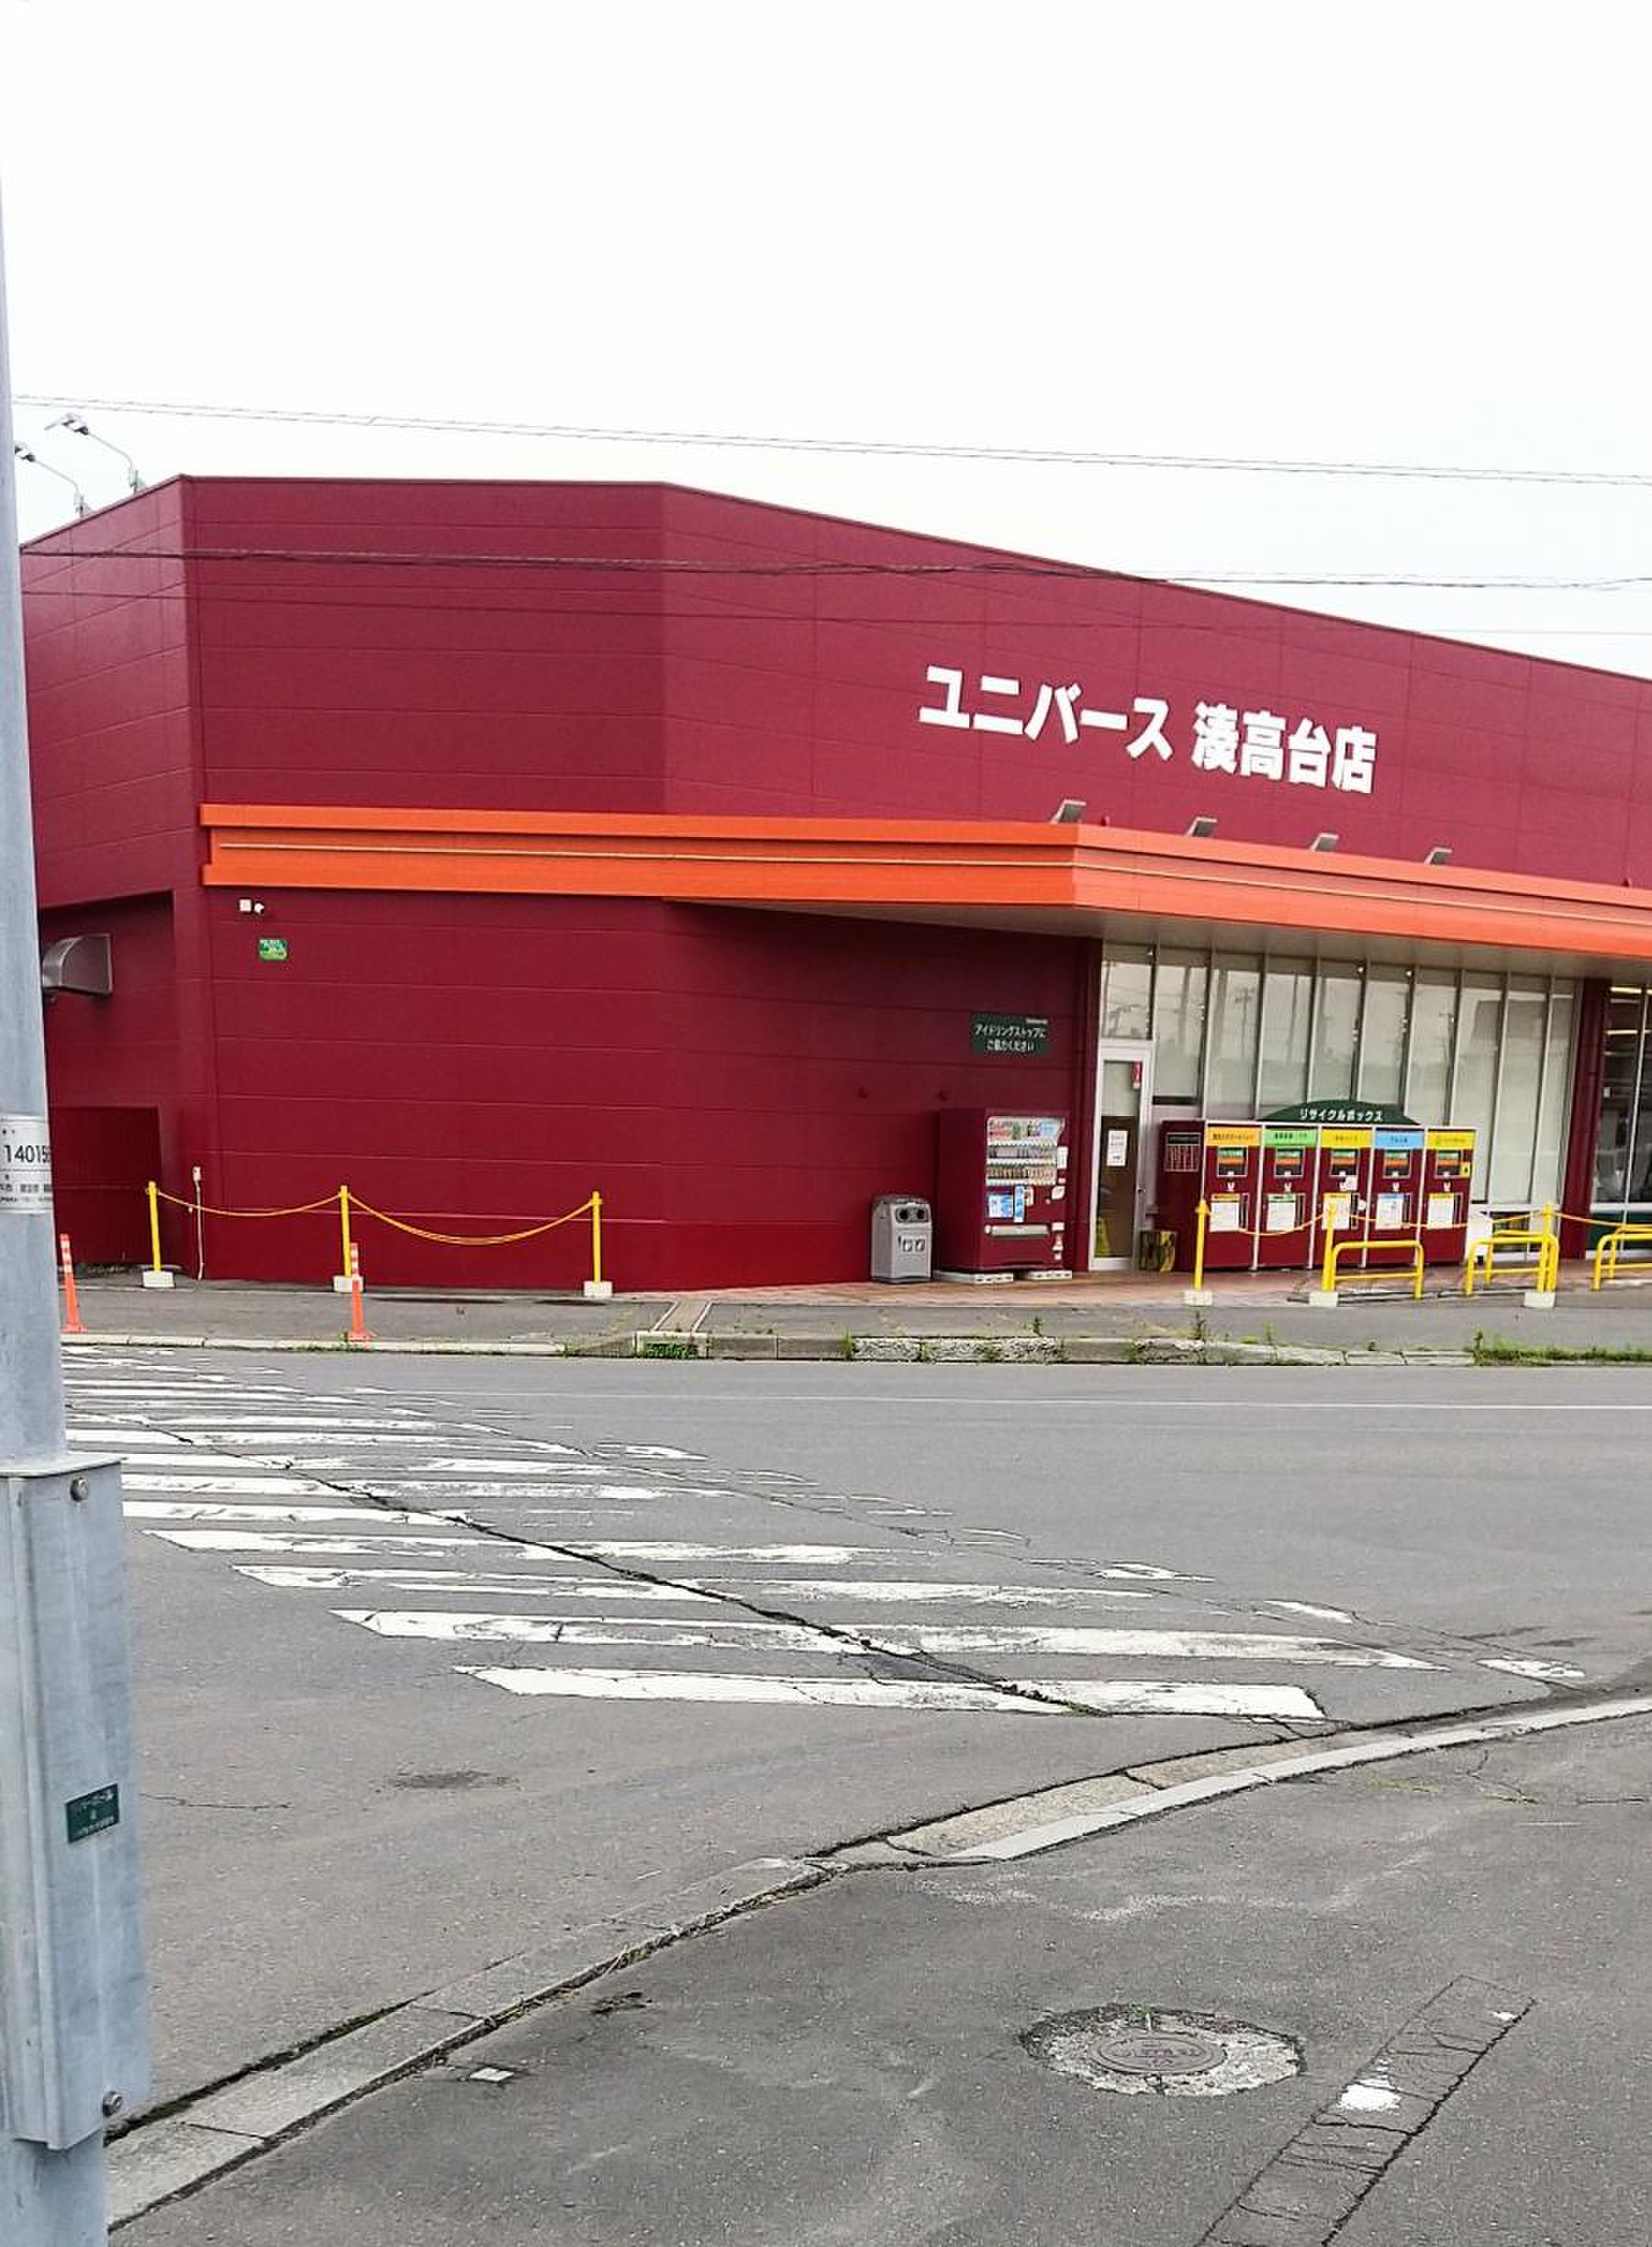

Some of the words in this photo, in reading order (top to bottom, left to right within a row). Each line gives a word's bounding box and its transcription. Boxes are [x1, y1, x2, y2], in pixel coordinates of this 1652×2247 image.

[919, 665, 1174, 761] ユニバース
[1191, 701, 1378, 794] 湊高台店
[1300, 1108, 1382, 1122] リサイクルボックス
